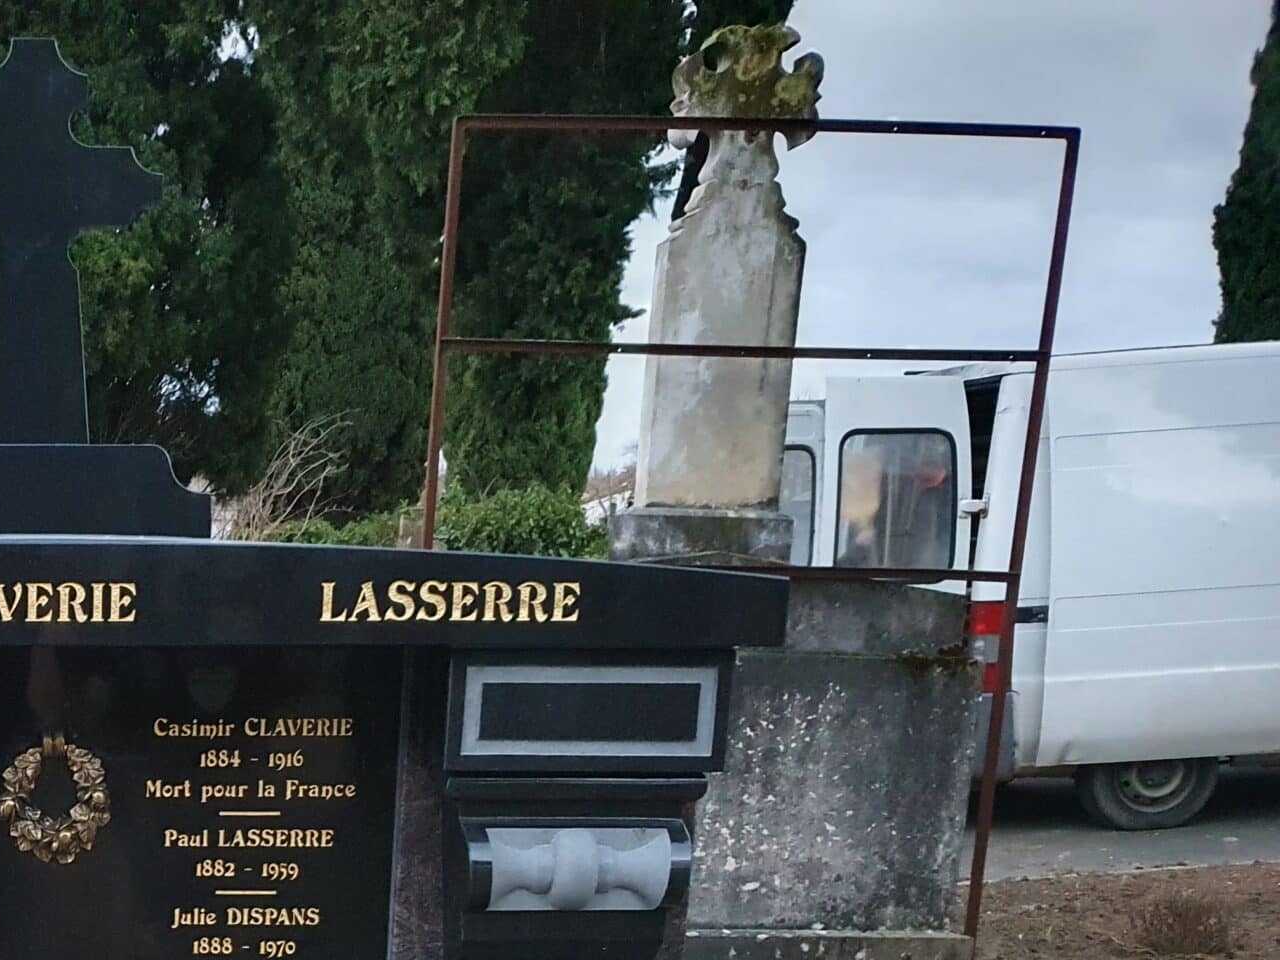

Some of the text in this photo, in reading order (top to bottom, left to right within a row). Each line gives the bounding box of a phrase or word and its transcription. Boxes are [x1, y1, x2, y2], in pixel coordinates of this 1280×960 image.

[320, 581, 580, 623] LASSERRE
[154, 718, 353, 740] Casimir CLAVERIE
[200, 750, 241, 768] 1884
[268, 750, 304, 770] 1916
[146, 779, 356, 803] Mort pour la France
[164, 829, 334, 847] Paul LASSERRE
[196, 859, 236, 877] 1882
[261, 862, 299, 881] 1959
[171, 908, 320, 929] Julie DISPANS
[192, 937, 233, 955] 1888
[259, 940, 296, 958] 1970
